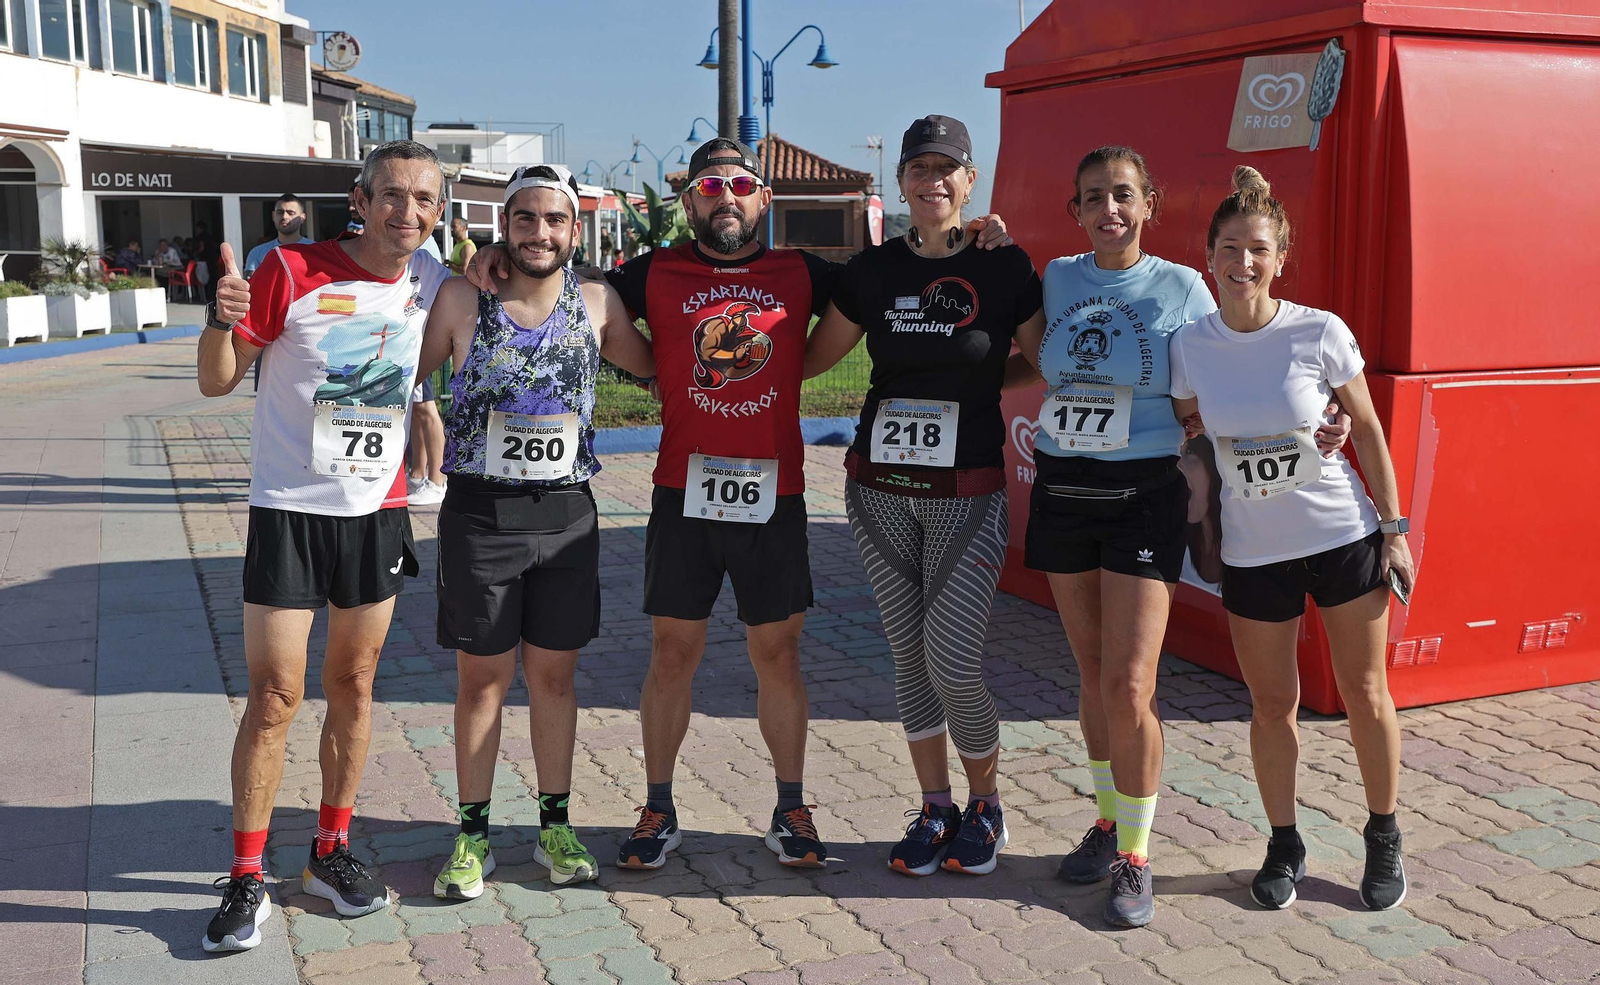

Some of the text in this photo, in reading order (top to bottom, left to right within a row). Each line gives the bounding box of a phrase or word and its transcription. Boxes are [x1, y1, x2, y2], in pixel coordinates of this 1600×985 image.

[1244, 115, 1291, 128] FRIGO
[92, 172, 172, 187] LO DE NATI
[682, 285, 784, 314] ESPARTANOS
[1063, 296, 1102, 317] URBANA
[884, 310, 924, 320] Turismo
[1108, 297, 1138, 321] CIUDAD
[892, 320, 955, 336] Running
[1040, 317, 1063, 353] CARRERA
[1133, 322, 1146, 334] DE
[1138, 338, 1153, 386] ALGECIRAS
[1059, 370, 1113, 382] Ayuntamiento
[688, 386, 778, 418] CERVECEROS
[332, 412, 392, 422] CARRERA URBANA
[885, 410, 904, 418] CIUDAD
[912, 412, 942, 420] ALGECIRAS
[1054, 406, 1114, 432] 177
[332, 419, 355, 427] CIUDAD
[356, 420, 364, 428] DE
[504, 425, 526, 434] CIUDAD
[882, 421, 941, 448] 218
[342, 431, 383, 458] 78
[502, 436, 564, 462] 260
[1232, 436, 1297, 450] CARRERA URBANA
[1256, 448, 1264, 456] DE
[1266, 443, 1298, 454] ALGECIRAS
[702, 467, 724, 476] CIUDAD
[703, 461, 733, 470] CARRERA
[1236, 453, 1300, 483] 107
[702, 478, 760, 504] 106
